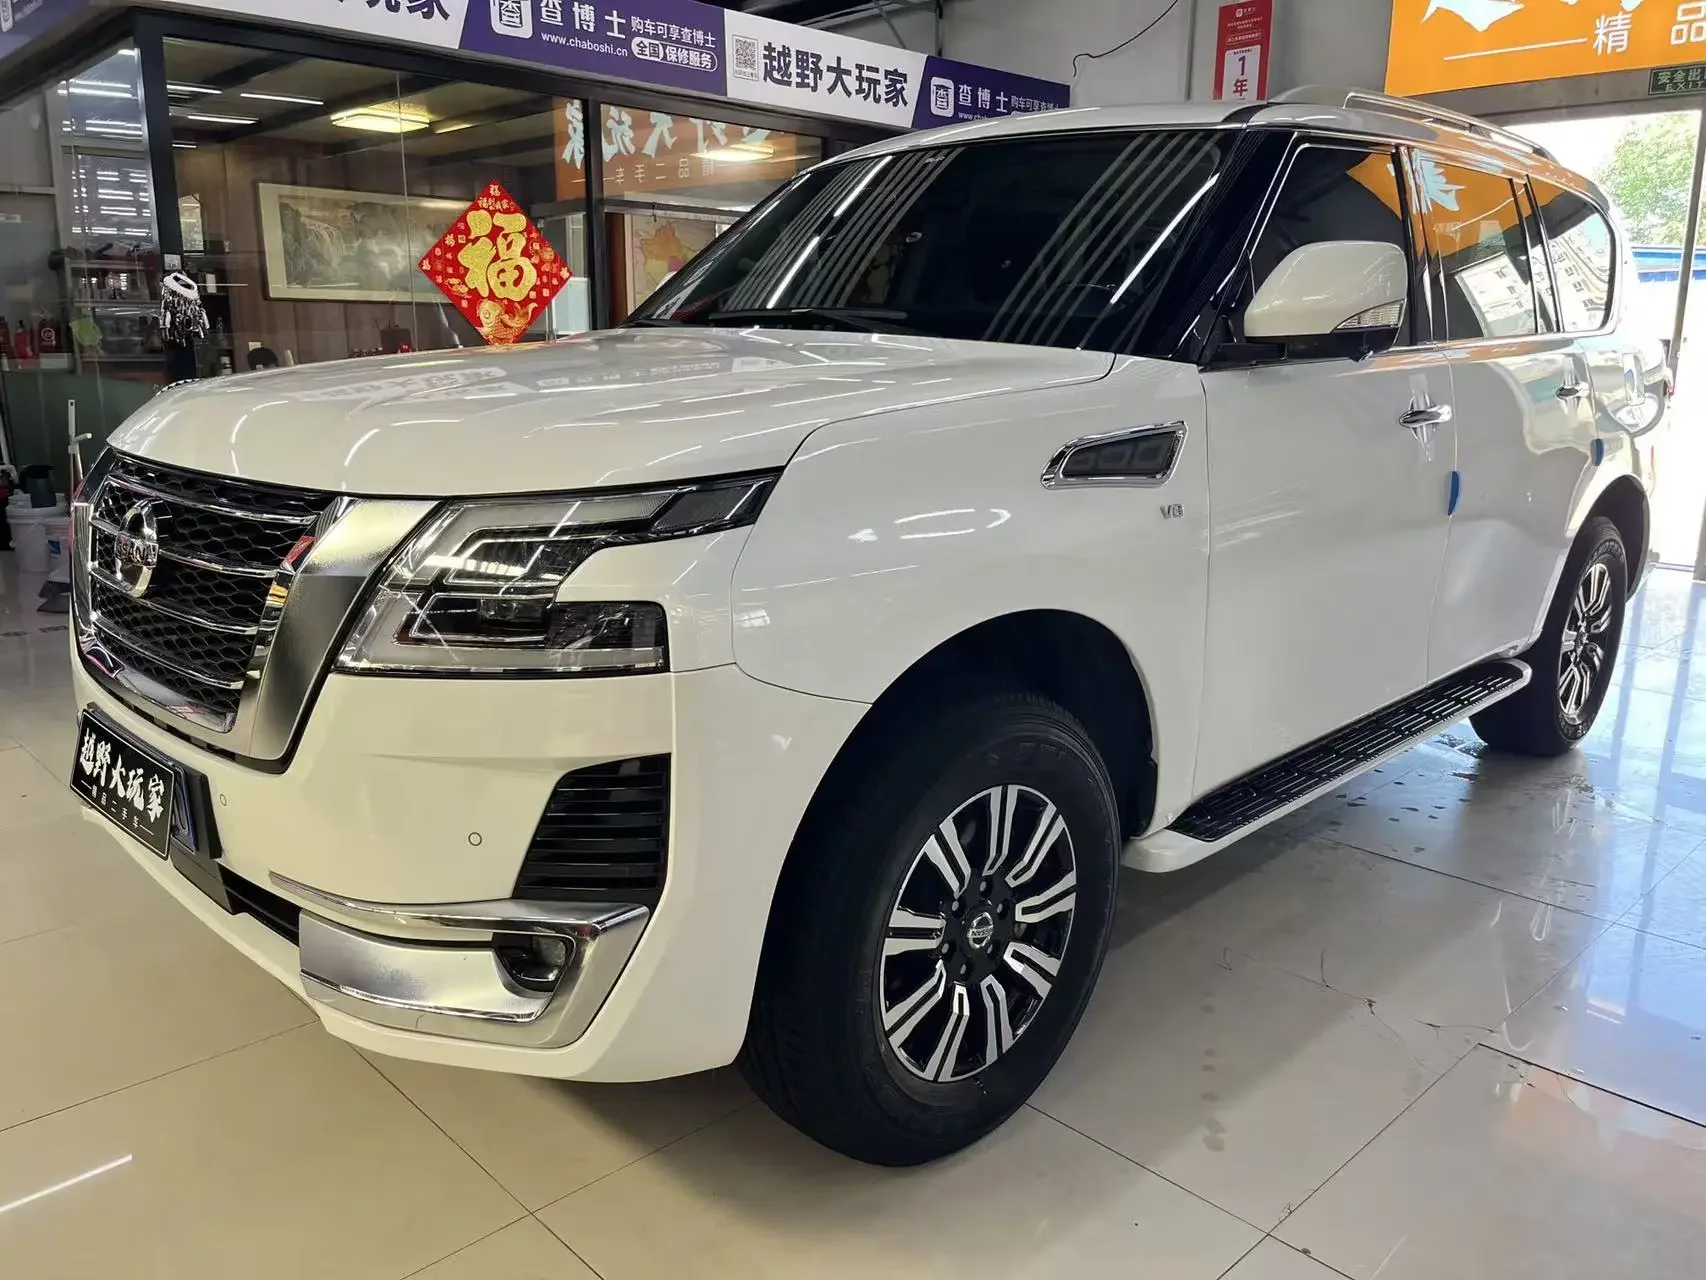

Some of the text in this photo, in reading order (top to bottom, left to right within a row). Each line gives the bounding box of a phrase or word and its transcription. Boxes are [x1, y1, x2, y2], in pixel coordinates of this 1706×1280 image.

[540, 0, 626, 38] 查博士
[631, 16, 716, 48] 购车可享查博士
[541, 32, 628, 57] www.chaboshi.cn
[763, 42, 908, 107] 越野大玩家
[1658, 68, 1706, 85] 安全出
[958, 84, 1008, 113] 查博士
[457, 209, 538, 302] 福
[79, 728, 165, 823] 越野大玩家
